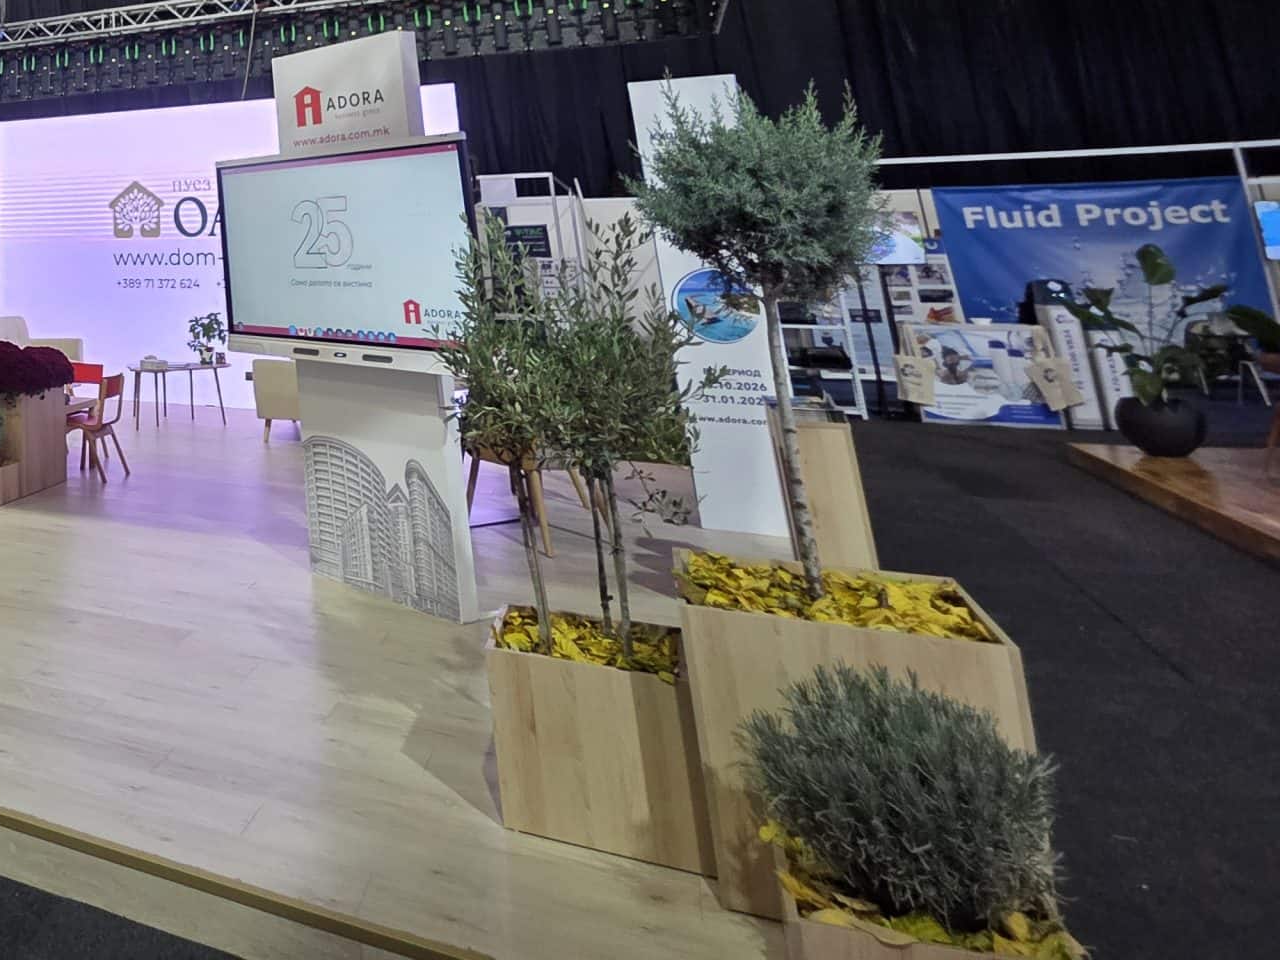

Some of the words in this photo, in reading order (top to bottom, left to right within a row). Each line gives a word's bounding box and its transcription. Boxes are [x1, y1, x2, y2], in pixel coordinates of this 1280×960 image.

[326, 89, 384, 111] ADORA
[293, 125, 390, 147] www.adora.com.mk
[962, 204, 1061, 229] Fluid
[1075, 200, 1231, 231] Project
[291, 196, 353, 269] 25
[158, 279, 176, 288] 372
[180, 279, 200, 288] 624
[424, 309, 461, 319] ADORA
[721, 368, 761, 378] ЕРИОД
[703, 395, 765, 406] 31.01.202
